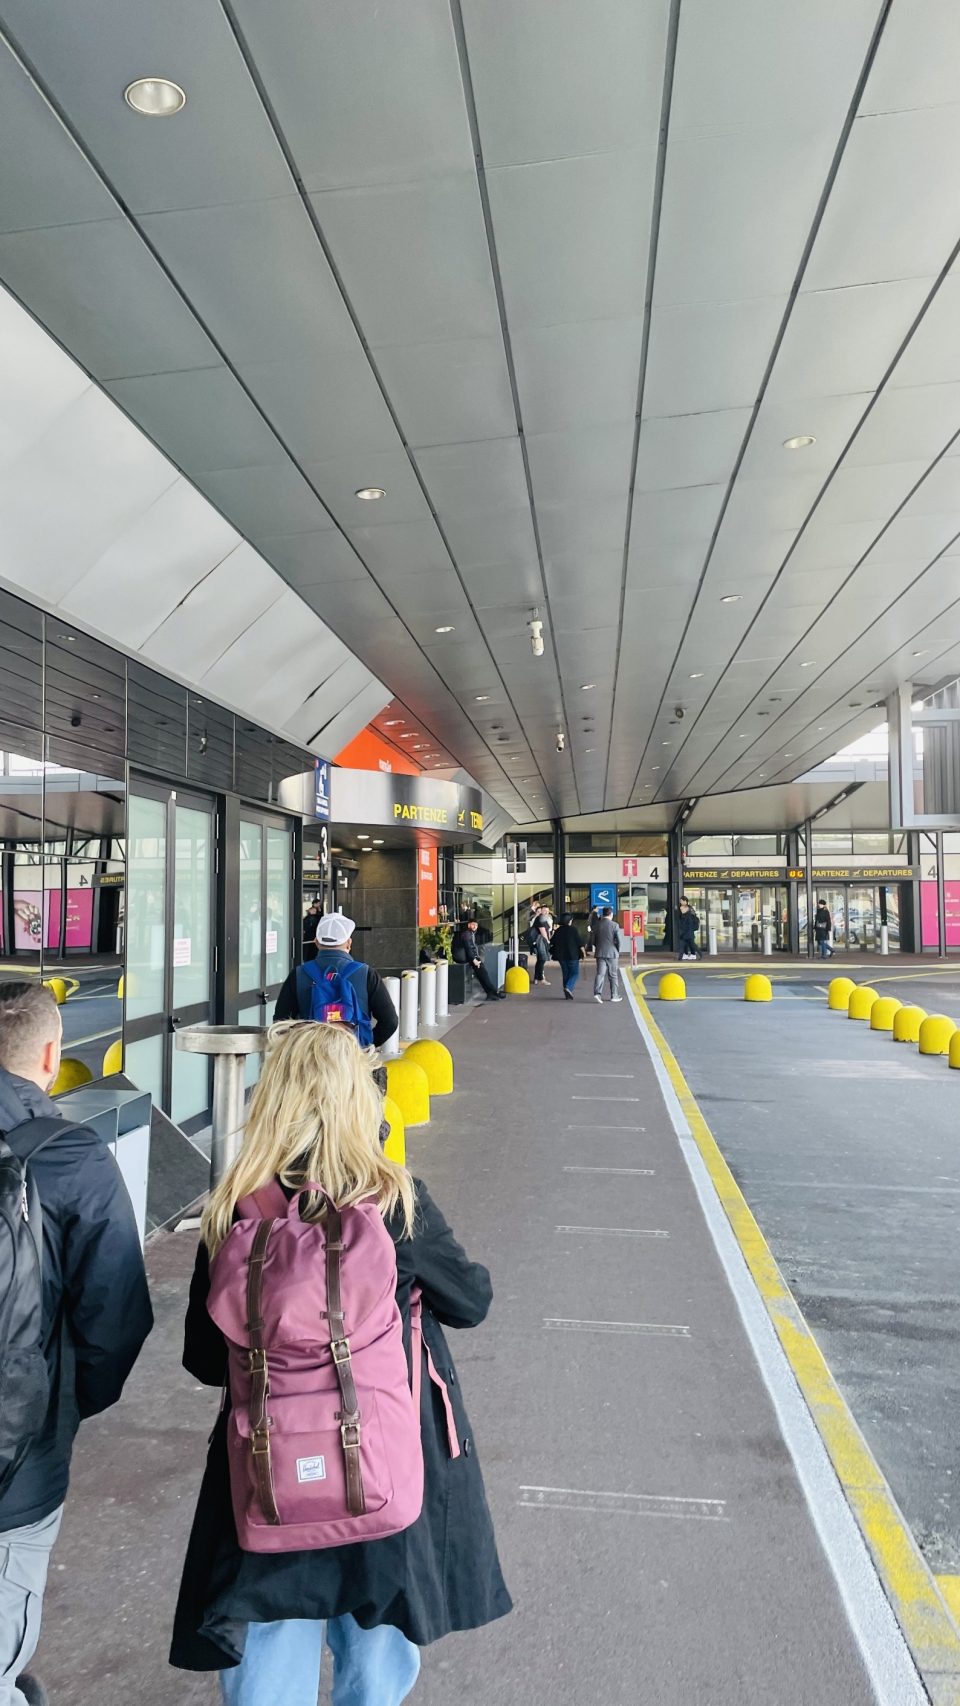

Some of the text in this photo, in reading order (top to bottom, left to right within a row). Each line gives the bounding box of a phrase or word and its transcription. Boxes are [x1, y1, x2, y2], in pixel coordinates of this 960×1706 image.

[394, 804, 447, 823] PARTENZE
[321, 827, 328, 864] 3
[650, 867, 659, 880] 4
[863, 869, 913, 877] DEPARTURES
[928, 865, 938, 878] 4
